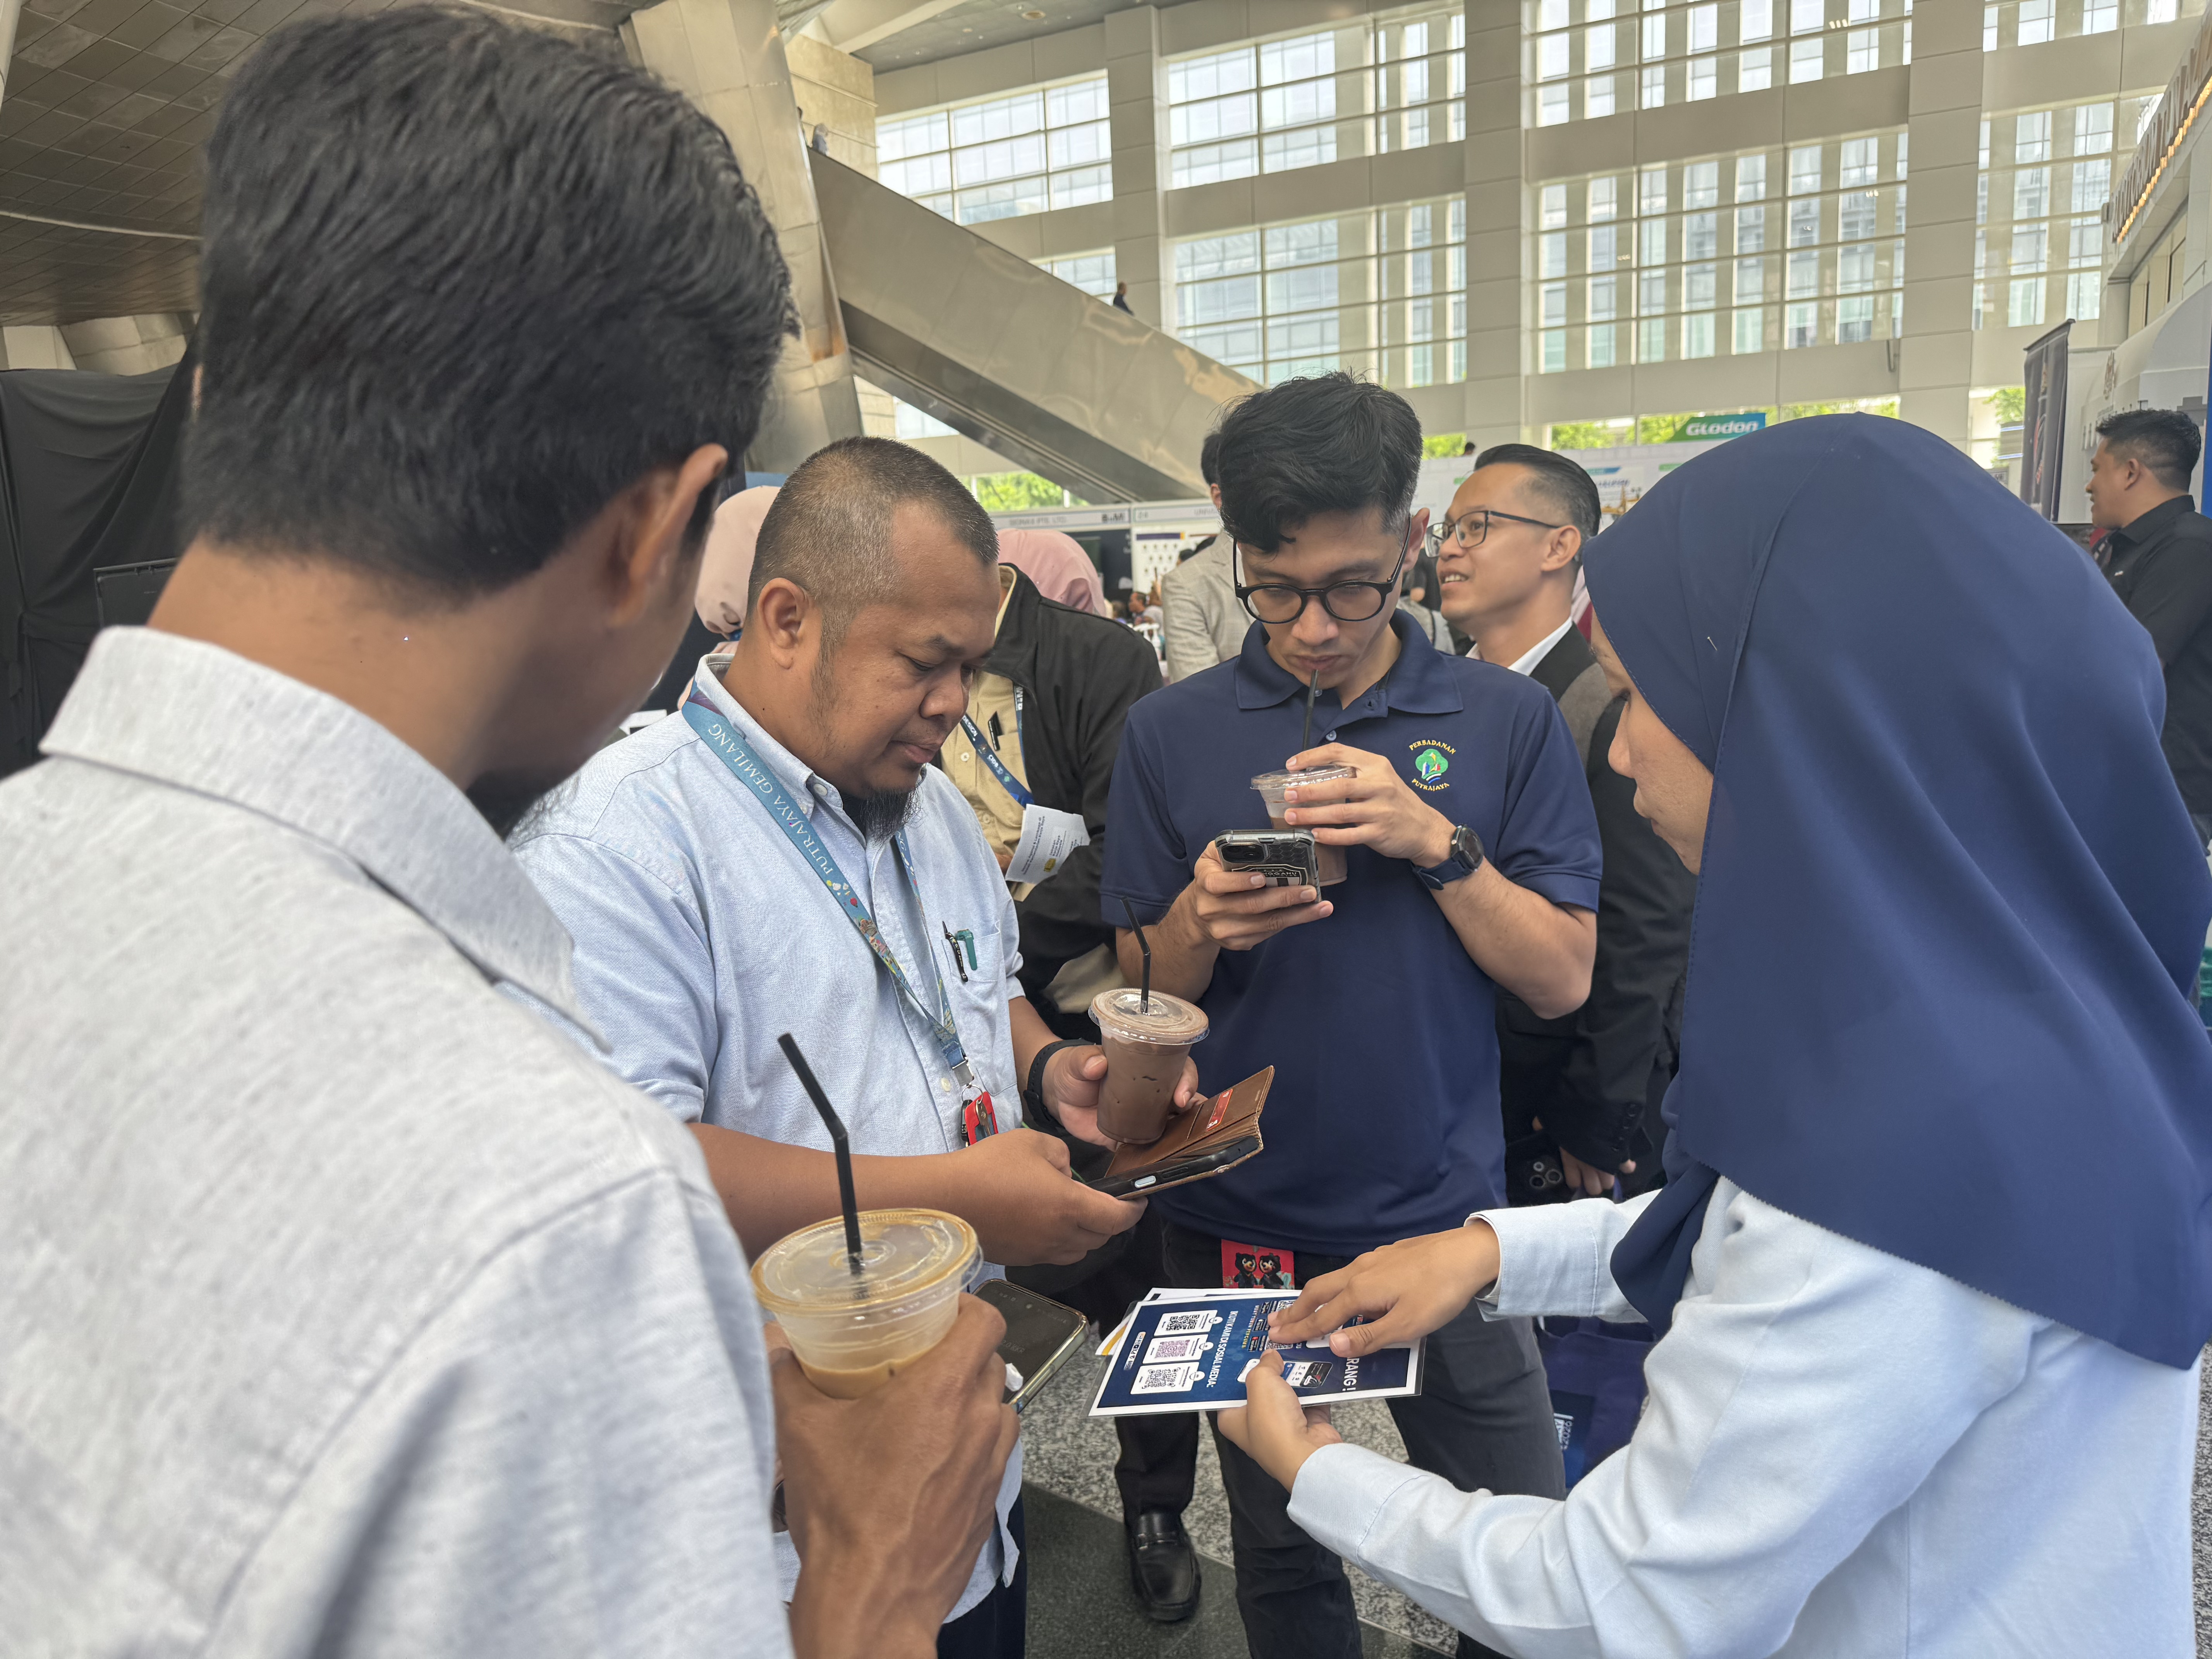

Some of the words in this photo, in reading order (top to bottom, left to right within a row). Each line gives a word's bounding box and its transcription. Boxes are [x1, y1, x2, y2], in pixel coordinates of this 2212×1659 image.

[1409, 740, 1456, 754] PERBADANAN
[708, 724, 773, 793] GEMILANG
[1412, 778, 1450, 792] PUTRAJAYA
[774, 795, 833, 875] PUTRAJAYA
[1221, 1323, 1234, 1337] KAMI
[1213, 1343, 1227, 1365] SOSIAL
[1206, 1365, 1221, 1388] MEDIA:
[1342, 1357, 1360, 1391] RANG!
